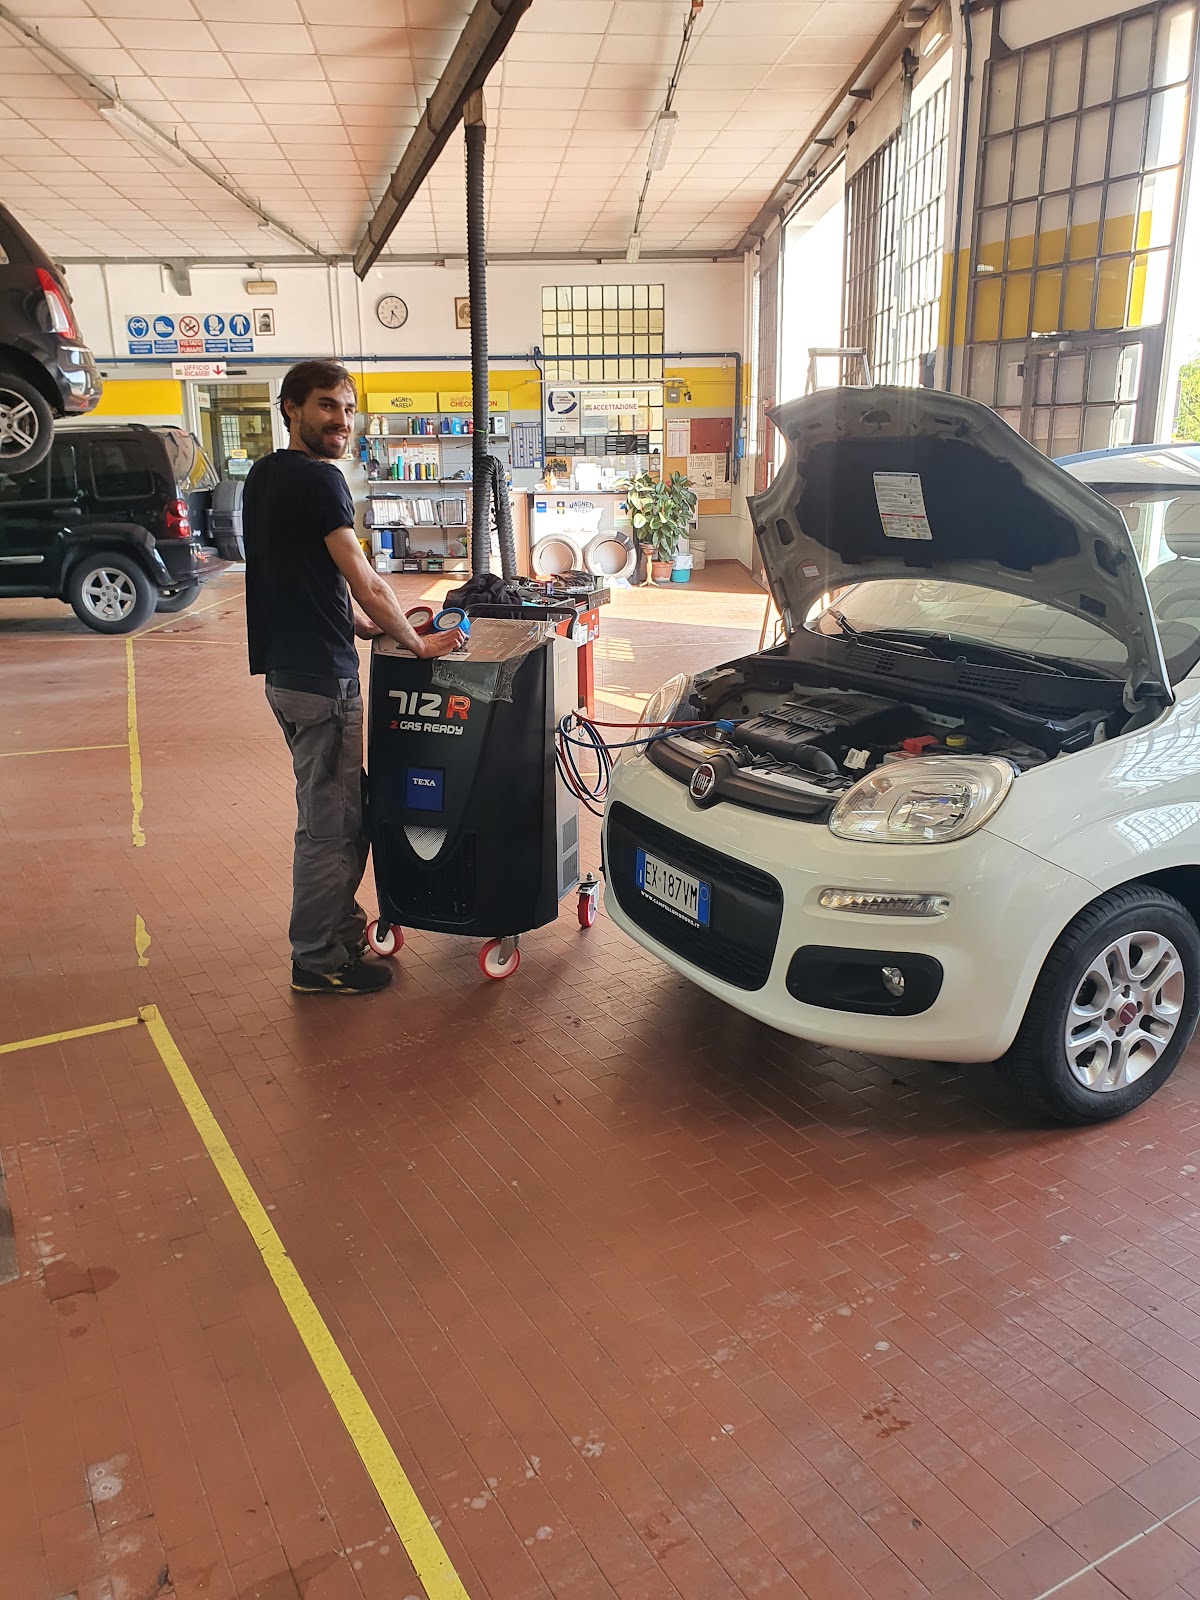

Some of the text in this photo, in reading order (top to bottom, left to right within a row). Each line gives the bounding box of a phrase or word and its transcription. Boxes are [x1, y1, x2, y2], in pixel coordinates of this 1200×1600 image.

[593, 403, 637, 411] ACCETTAZIONE
[388, 689, 471, 720] 712 R
[390, 720, 464, 736] 2 GAS READY
[412, 777, 436, 787] TEXA
[694, 772, 710, 791] FIAT
